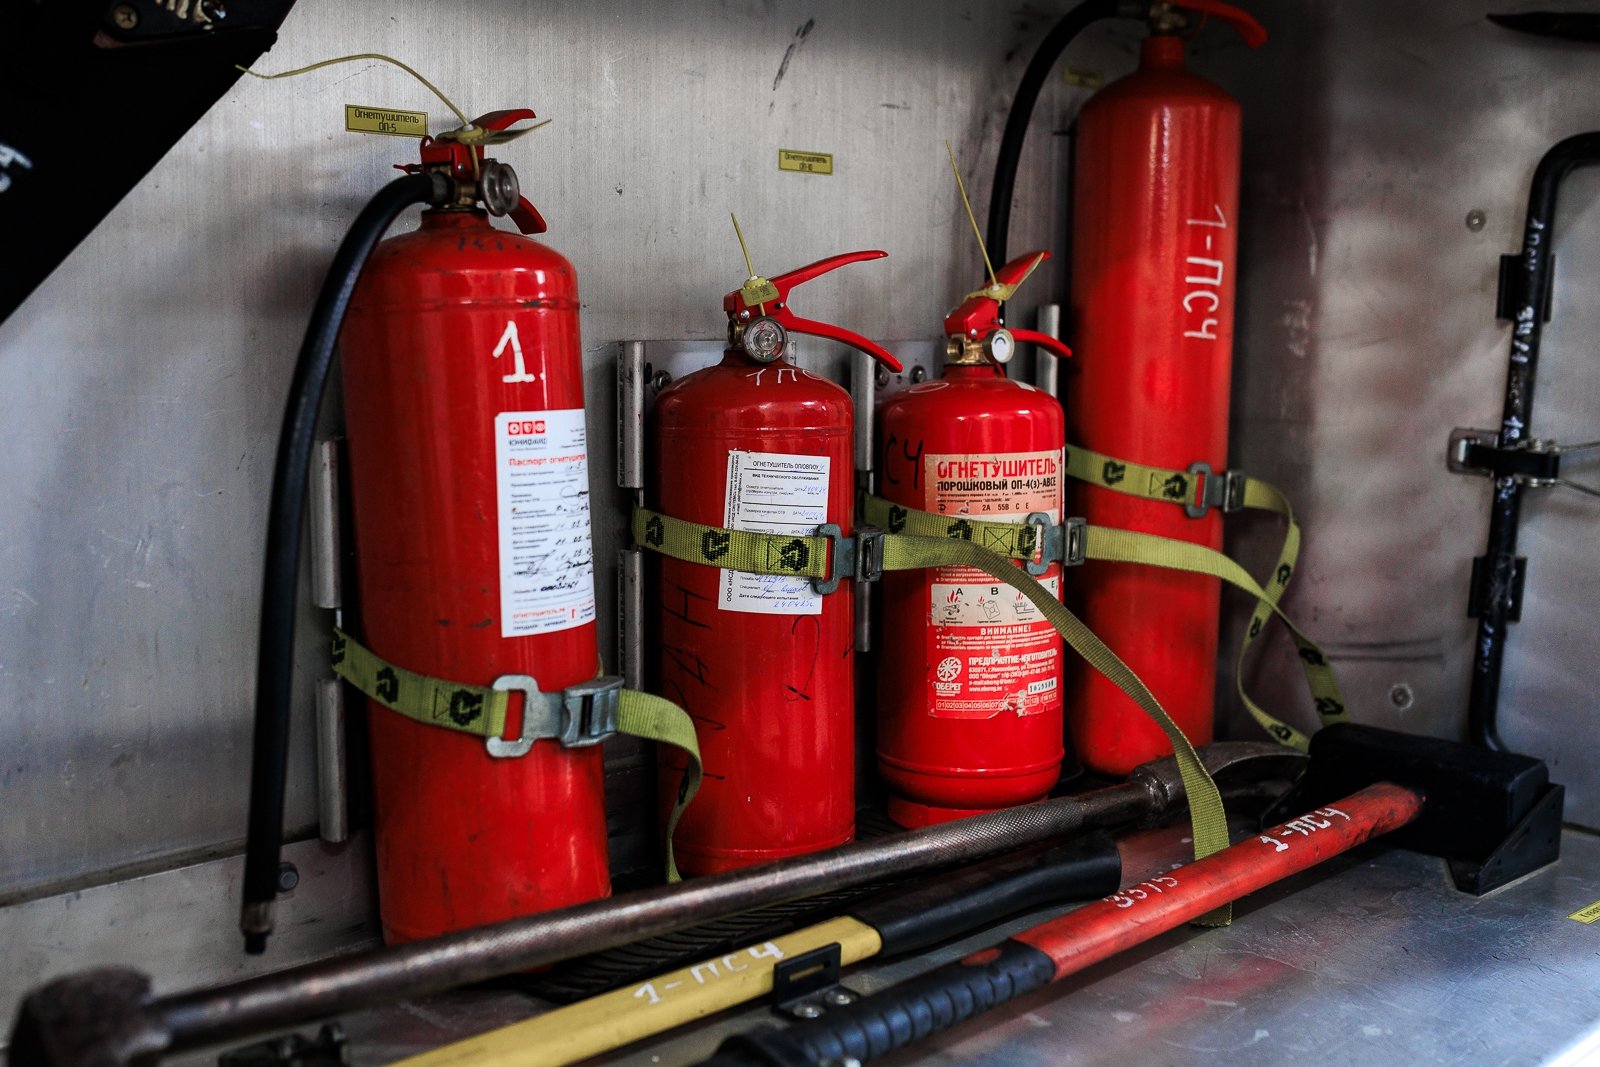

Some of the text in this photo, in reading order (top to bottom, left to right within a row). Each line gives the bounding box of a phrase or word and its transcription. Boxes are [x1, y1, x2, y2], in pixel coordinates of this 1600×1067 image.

[354, 108, 419, 124] Огнетушитель
[378, 122, 397, 132] ОП-5
[1183, 204, 1226, 340] 1-ПСЧ
[752, 460, 794, 469] ОГНЕТУШИТЕЛЬ
[937, 458, 1056, 479] ОГНЕТУШИТЕЛЬ
[937, 479, 1008, 491] ПОРОШКОВЫЙ
[979, 625, 1031, 636] ВНИМАНИЕ!
[1259, 807, 1350, 852] 1-ПСЧ
[633, 941, 784, 1005] 1-ПСЧ
